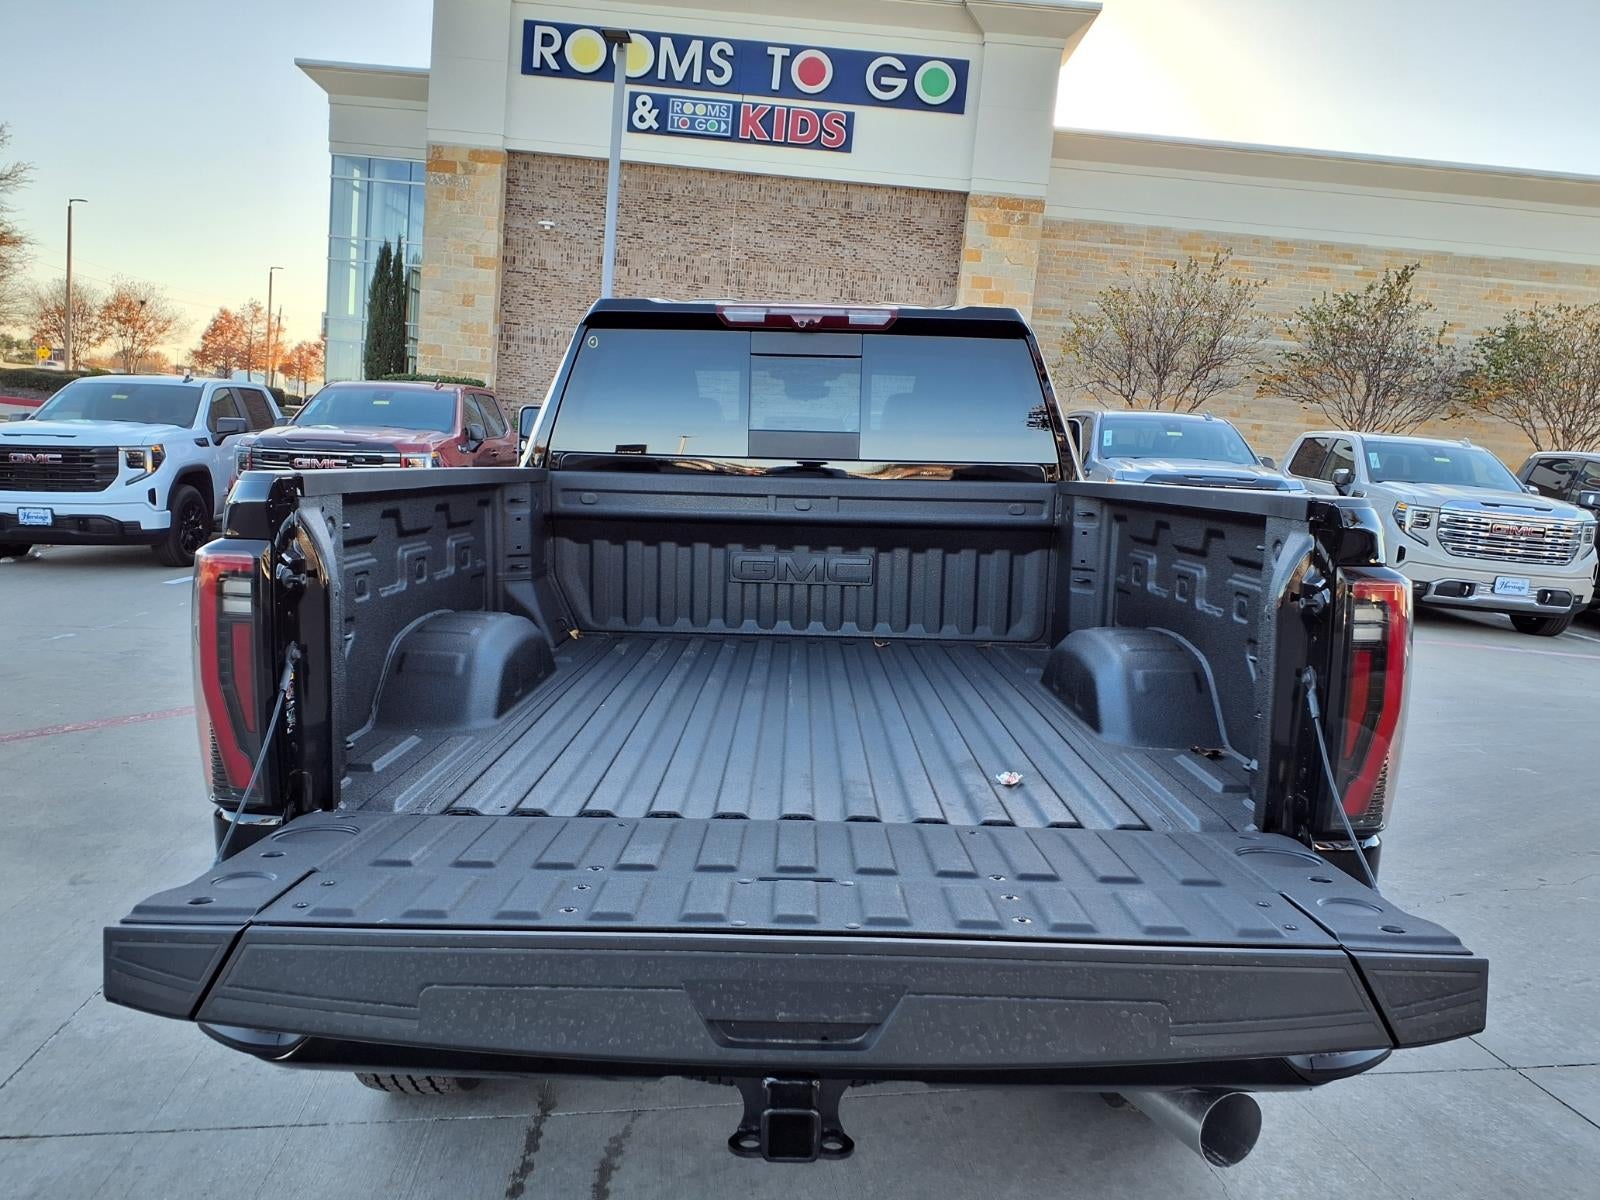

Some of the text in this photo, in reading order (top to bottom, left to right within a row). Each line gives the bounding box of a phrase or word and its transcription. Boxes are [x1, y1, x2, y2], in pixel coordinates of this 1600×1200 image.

[532, 24, 957, 105] ROOMS TO GO
[632, 94, 659, 130] &
[673, 101, 728, 118] ROOMS
[673, 116, 719, 131] TO GO
[739, 103, 848, 149] KIDS
[8, 452, 63, 464] GMC
[293, 457, 348, 469] GMC
[1492, 524, 1545, 537] GMC
[732, 554, 872, 583] GMC
